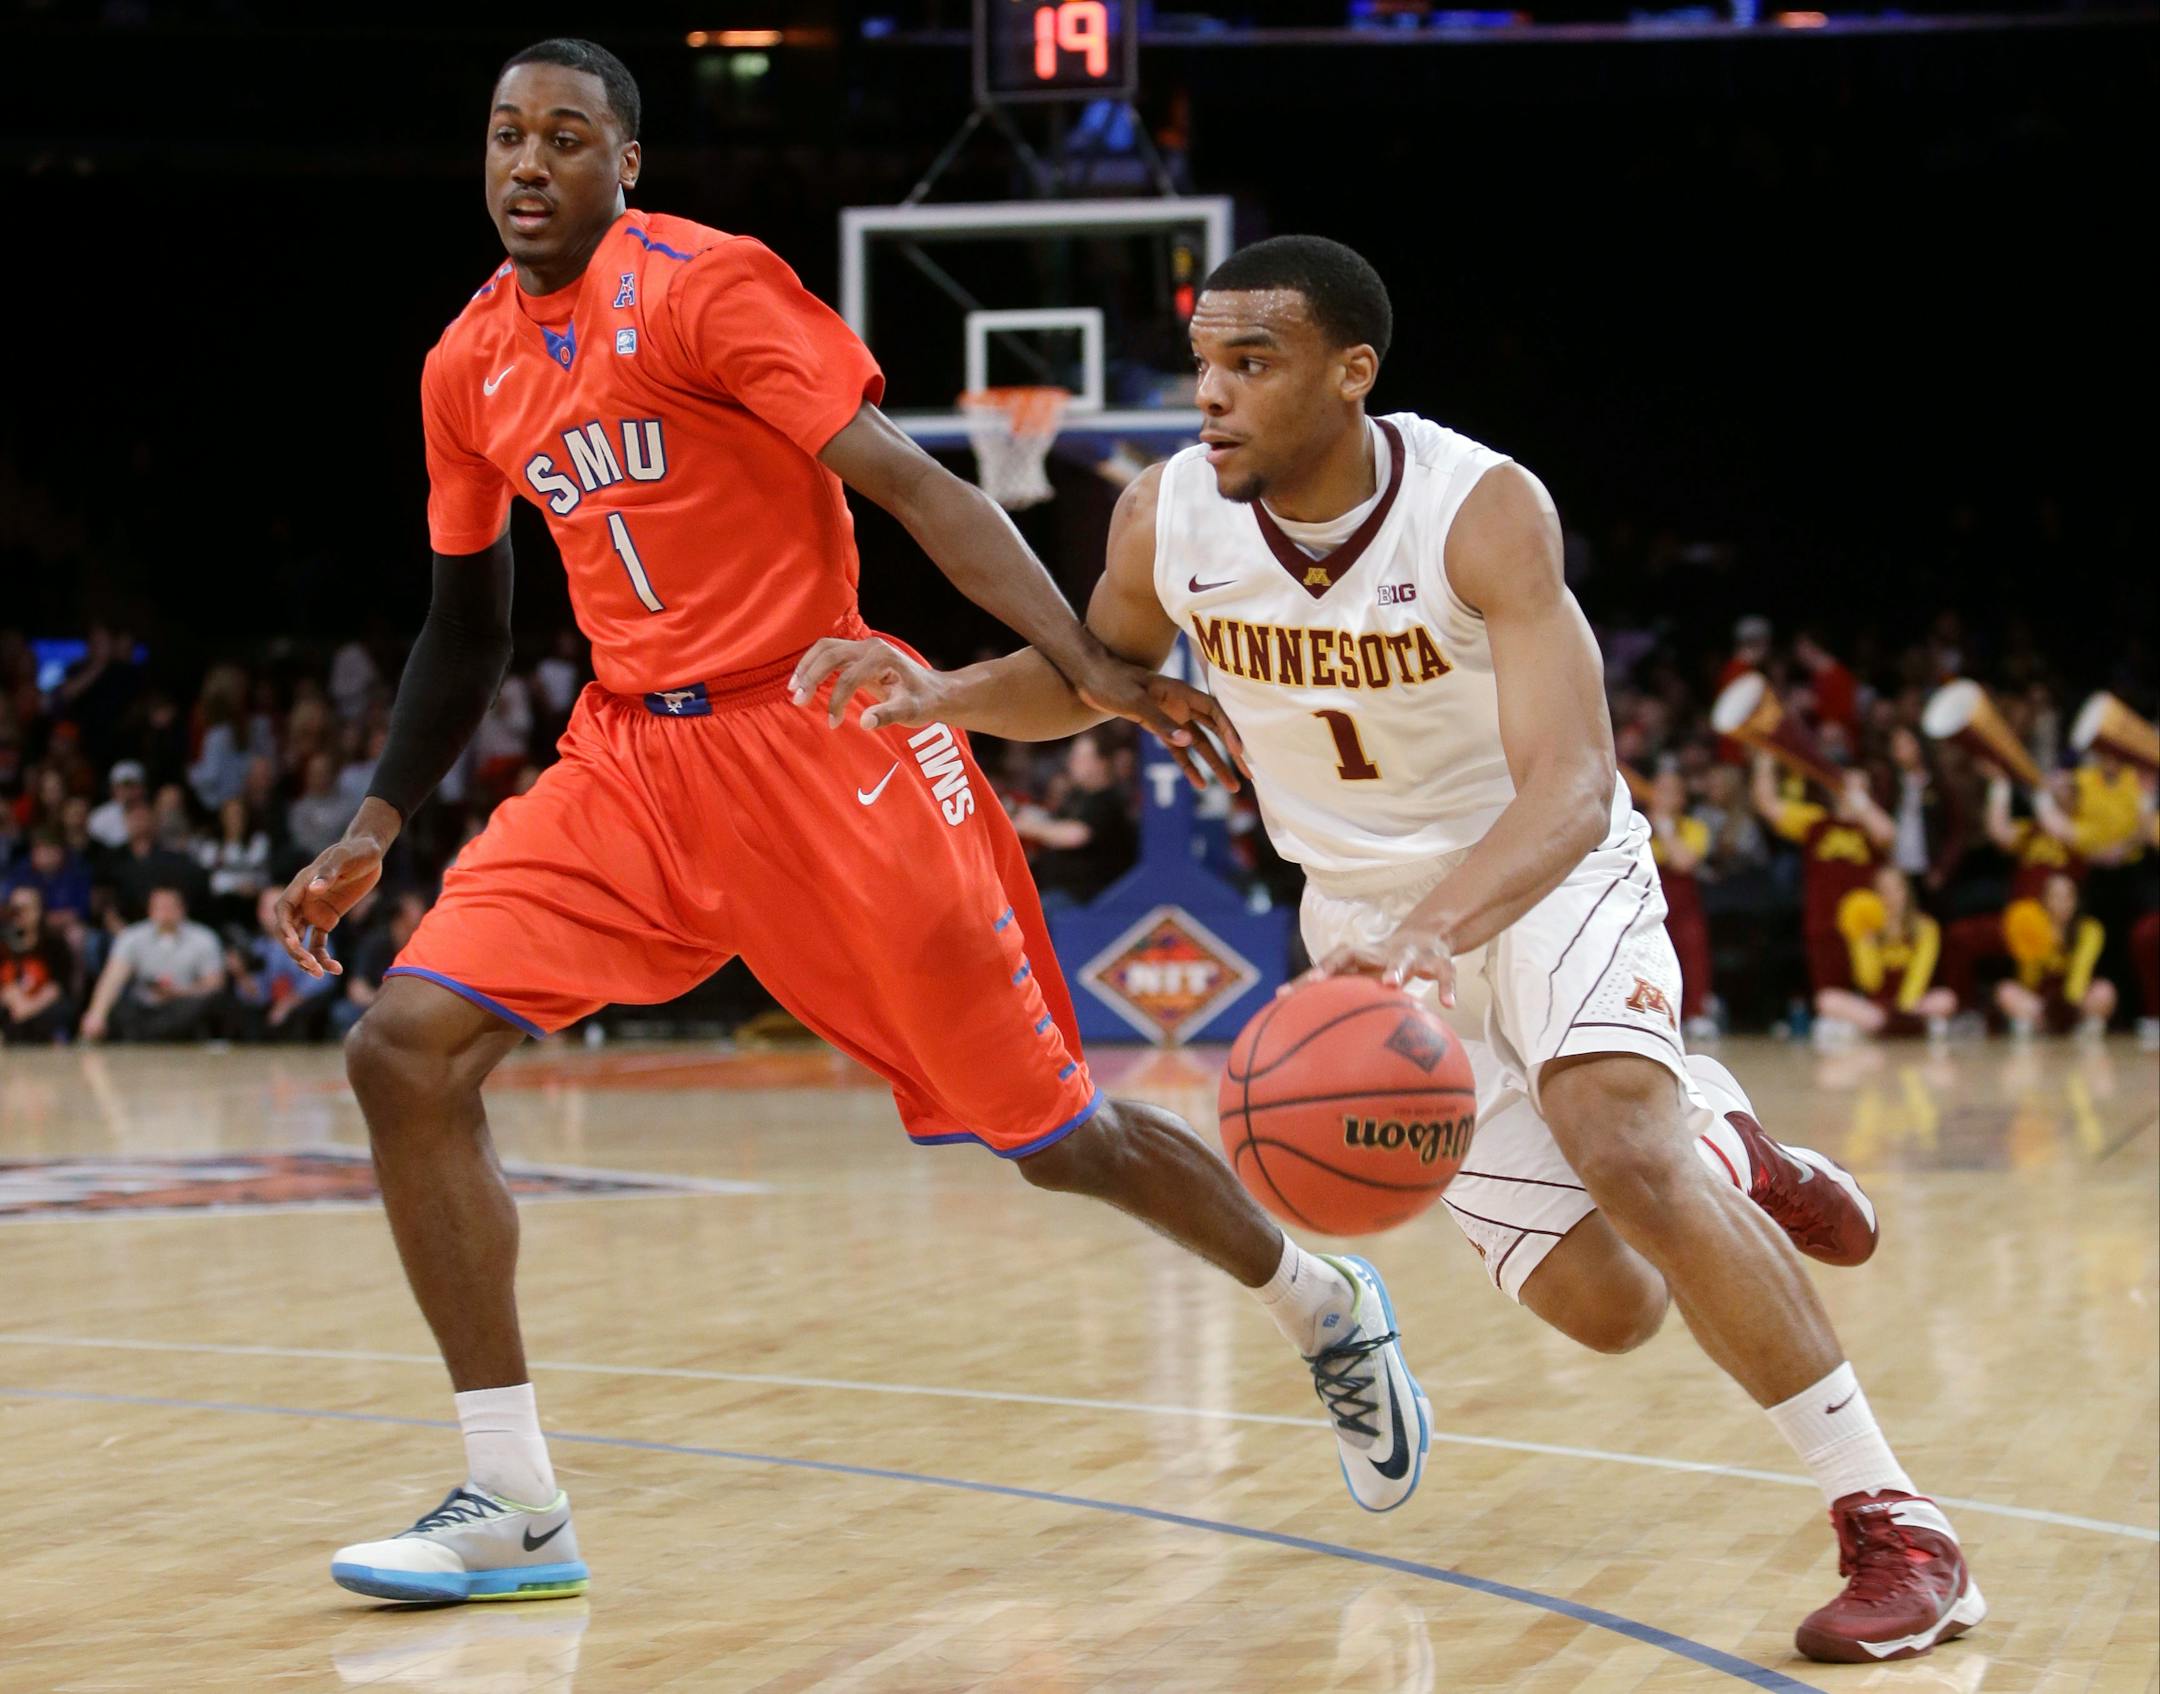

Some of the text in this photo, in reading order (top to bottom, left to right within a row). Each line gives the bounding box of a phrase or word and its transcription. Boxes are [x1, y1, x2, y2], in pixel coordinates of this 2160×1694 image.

[1034, 1, 1108, 80] 19
[525, 417, 668, 517] SMU
[607, 511, 666, 614] 1
[1189, 609, 1455, 691] MINNESOTA
[906, 720, 975, 828] SMU
[1312, 708, 1383, 781] 1
[1343, 1113, 1475, 1167] Wilson
